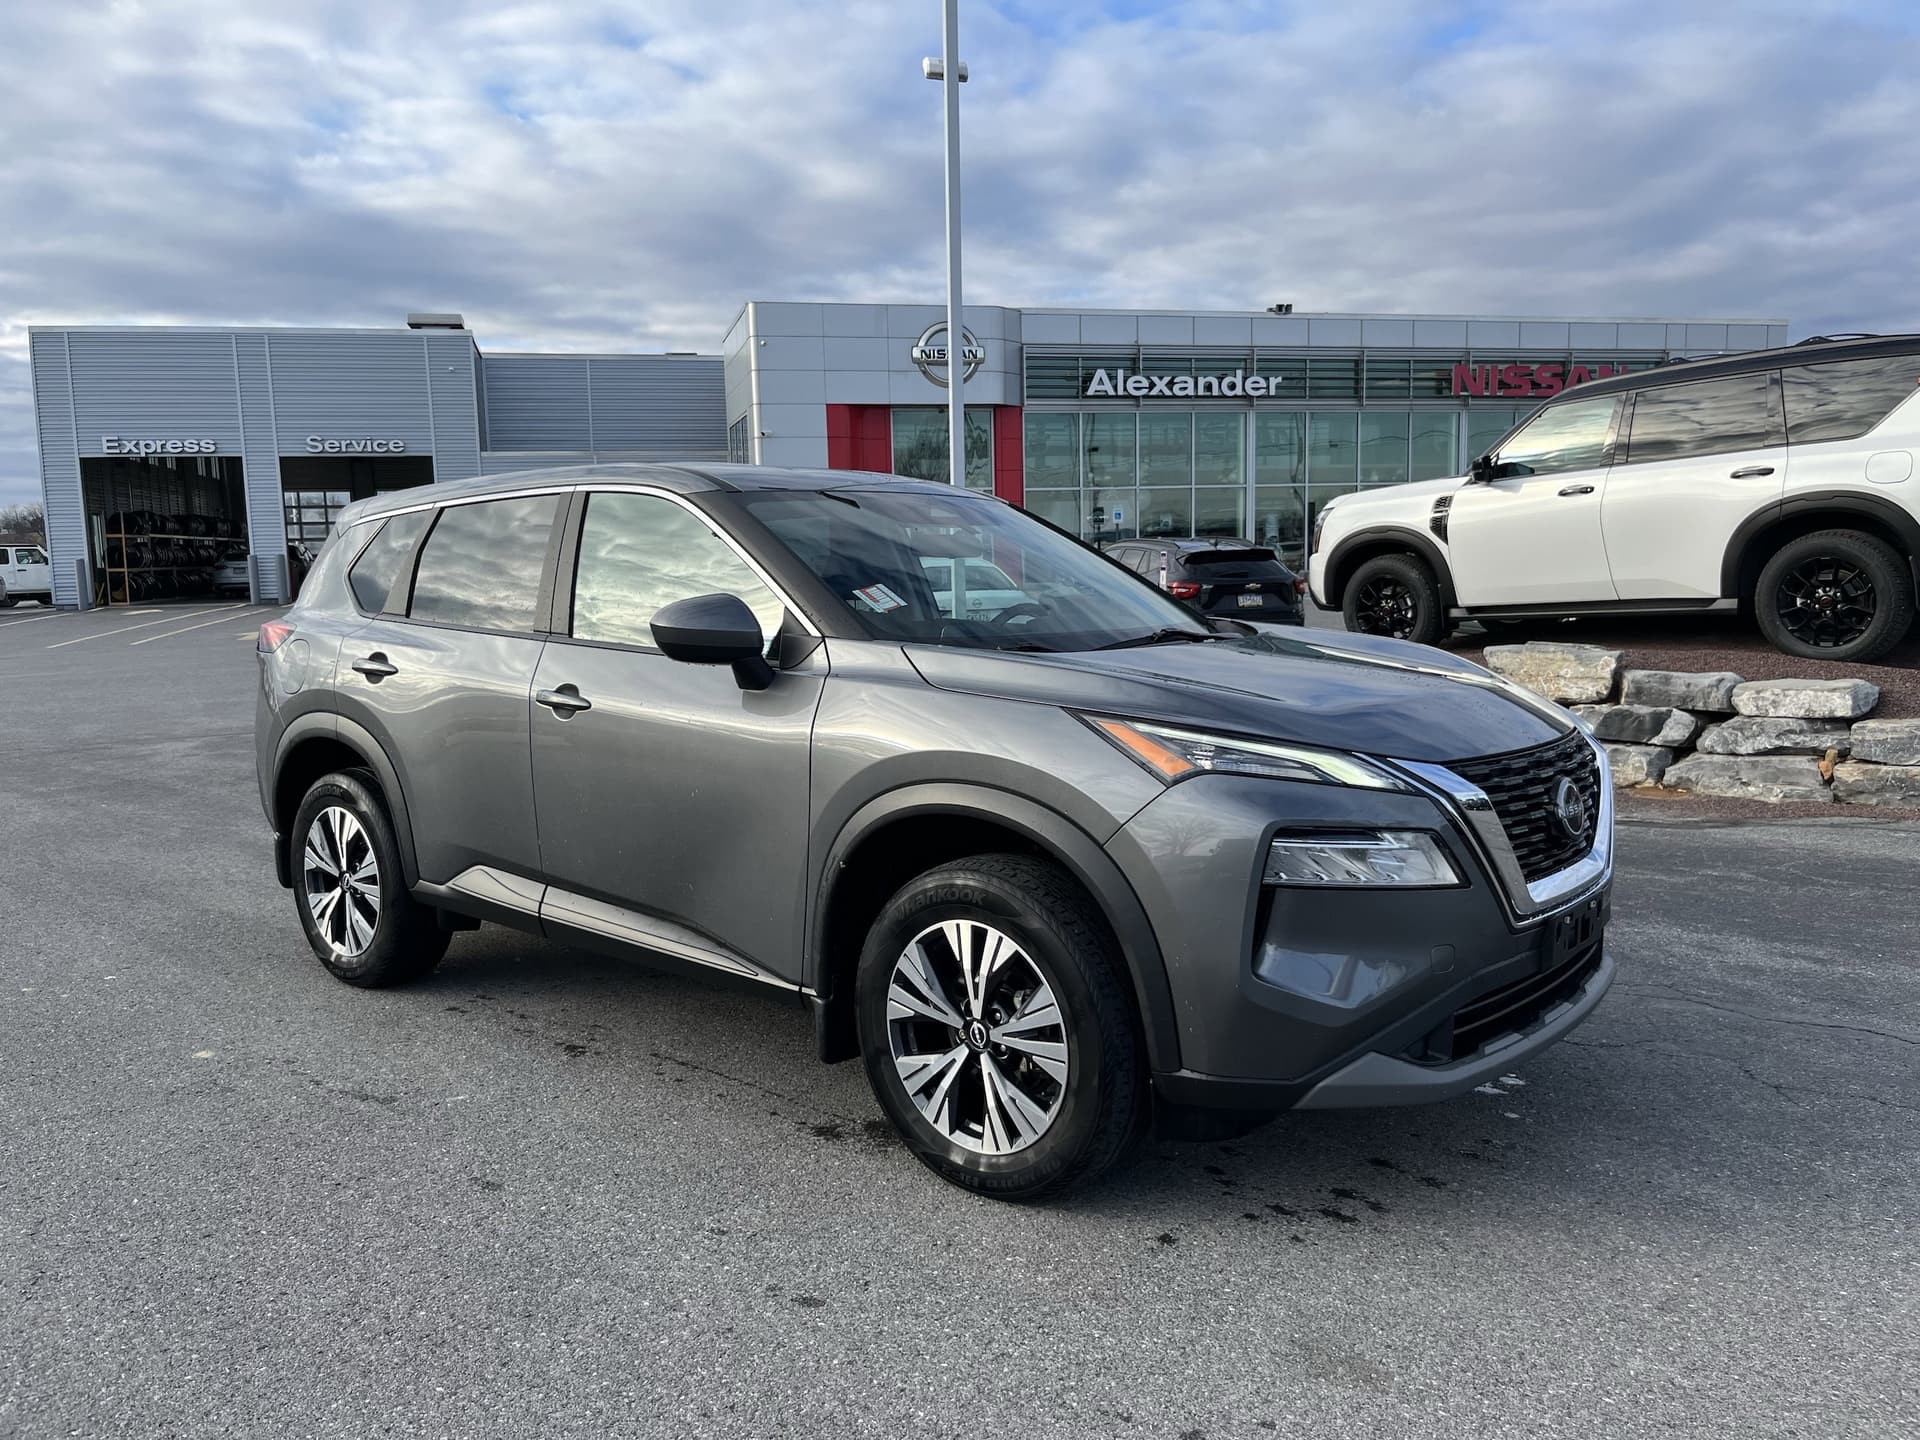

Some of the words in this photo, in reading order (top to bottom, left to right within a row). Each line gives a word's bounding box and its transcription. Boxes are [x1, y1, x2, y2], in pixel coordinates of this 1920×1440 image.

[1086, 368, 1283, 397] Alexander
[101, 435, 217, 457] Express
[306, 434, 405, 453] Service
